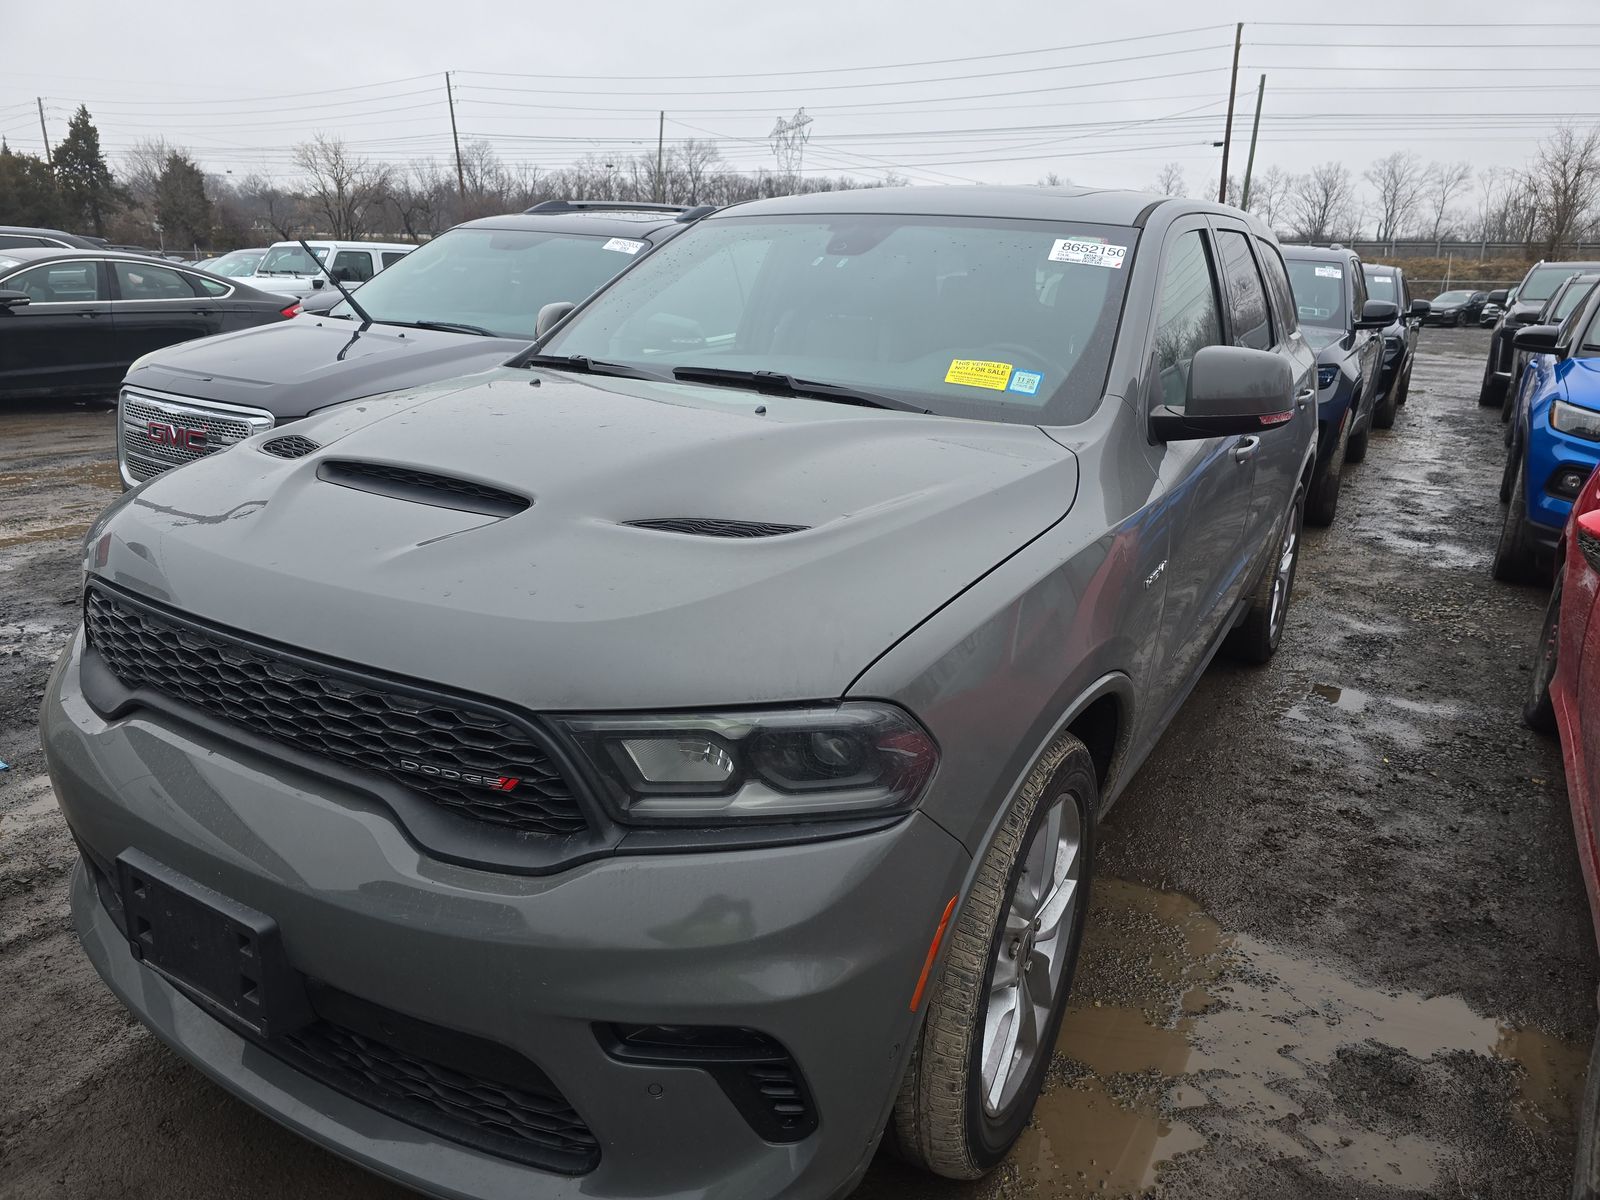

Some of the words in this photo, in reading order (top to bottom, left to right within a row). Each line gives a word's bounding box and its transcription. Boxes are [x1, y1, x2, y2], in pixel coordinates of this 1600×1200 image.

[1062, 242, 1126, 258] 8652150
[972, 361, 1001, 369] VEHICLE
[147, 420, 207, 453] GMC
[400, 759, 503, 787] DODGE
